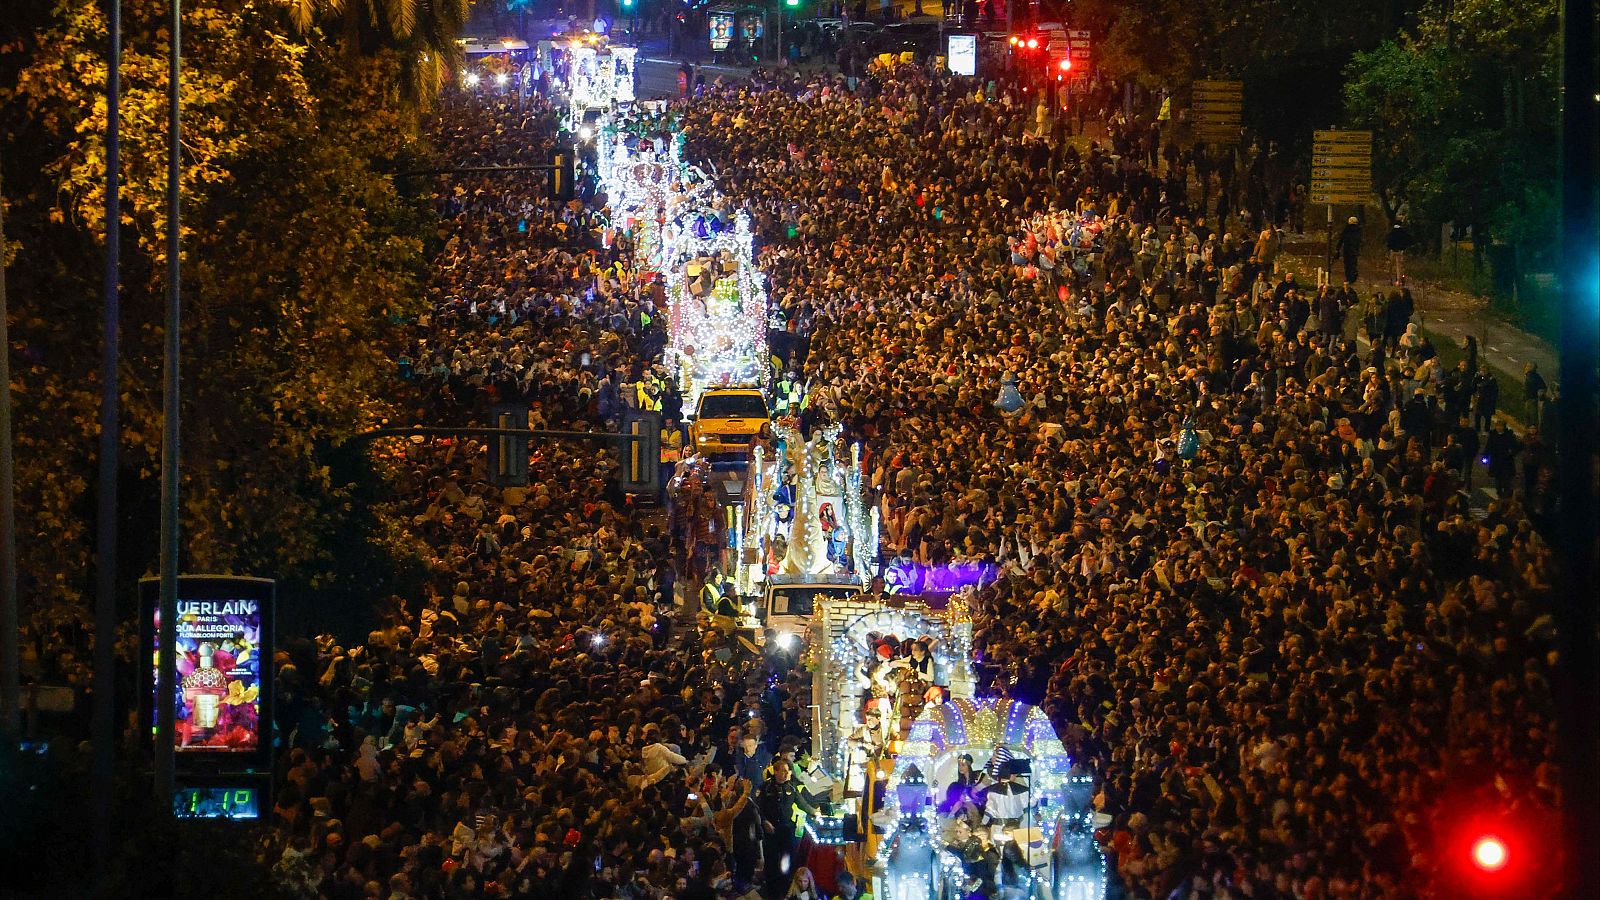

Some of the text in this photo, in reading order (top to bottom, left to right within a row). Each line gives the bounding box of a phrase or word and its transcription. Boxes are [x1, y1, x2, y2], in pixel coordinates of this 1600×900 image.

[176, 601, 253, 615] UERLAIN
[175, 624, 244, 632] QUA ALLEGORIA
